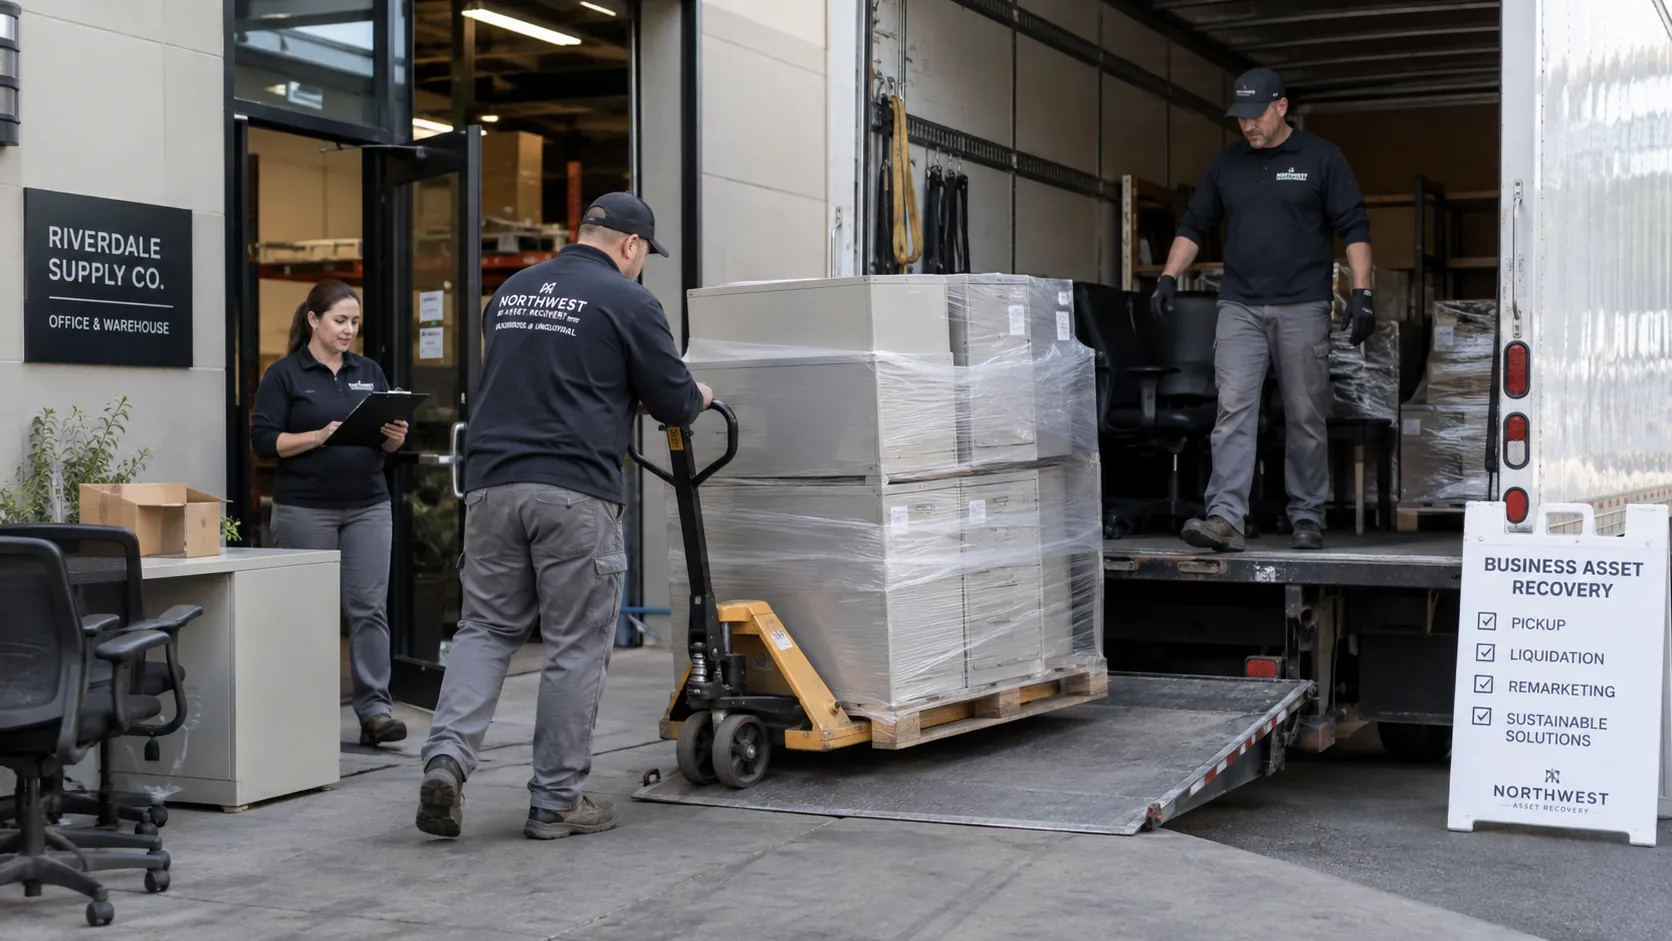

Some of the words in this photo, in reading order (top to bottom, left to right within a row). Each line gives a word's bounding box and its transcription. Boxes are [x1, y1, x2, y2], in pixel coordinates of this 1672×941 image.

[49, 226, 161, 259] RIVERDALE
[49, 258, 126, 285] SUPPLY
[132, 266, 165, 290] CO.
[499, 295, 587, 312] NORTHWEST
[49, 315, 90, 330] OFFICE
[92, 317, 101, 331] &
[103, 318, 169, 334] WAREHOUSE
[1484, 557, 1577, 575] BUSINESS
[1582, 560, 1644, 577] ASSET
[1512, 580, 1613, 598] RECOVERY
[1511, 617, 1566, 631] PICKUP
[1510, 649, 1604, 665] LIQUIDATION
[1508, 681, 1615, 698] REMARKETING
[1506, 712, 1607, 730] SUSTAINABLE
[1505, 730, 1591, 747] SOLUTIONS
[1493, 784, 1609, 806] NORTHWEST
[1512, 802, 1540, 811] ASSET
[1543, 805, 1589, 816] RECOVERY
